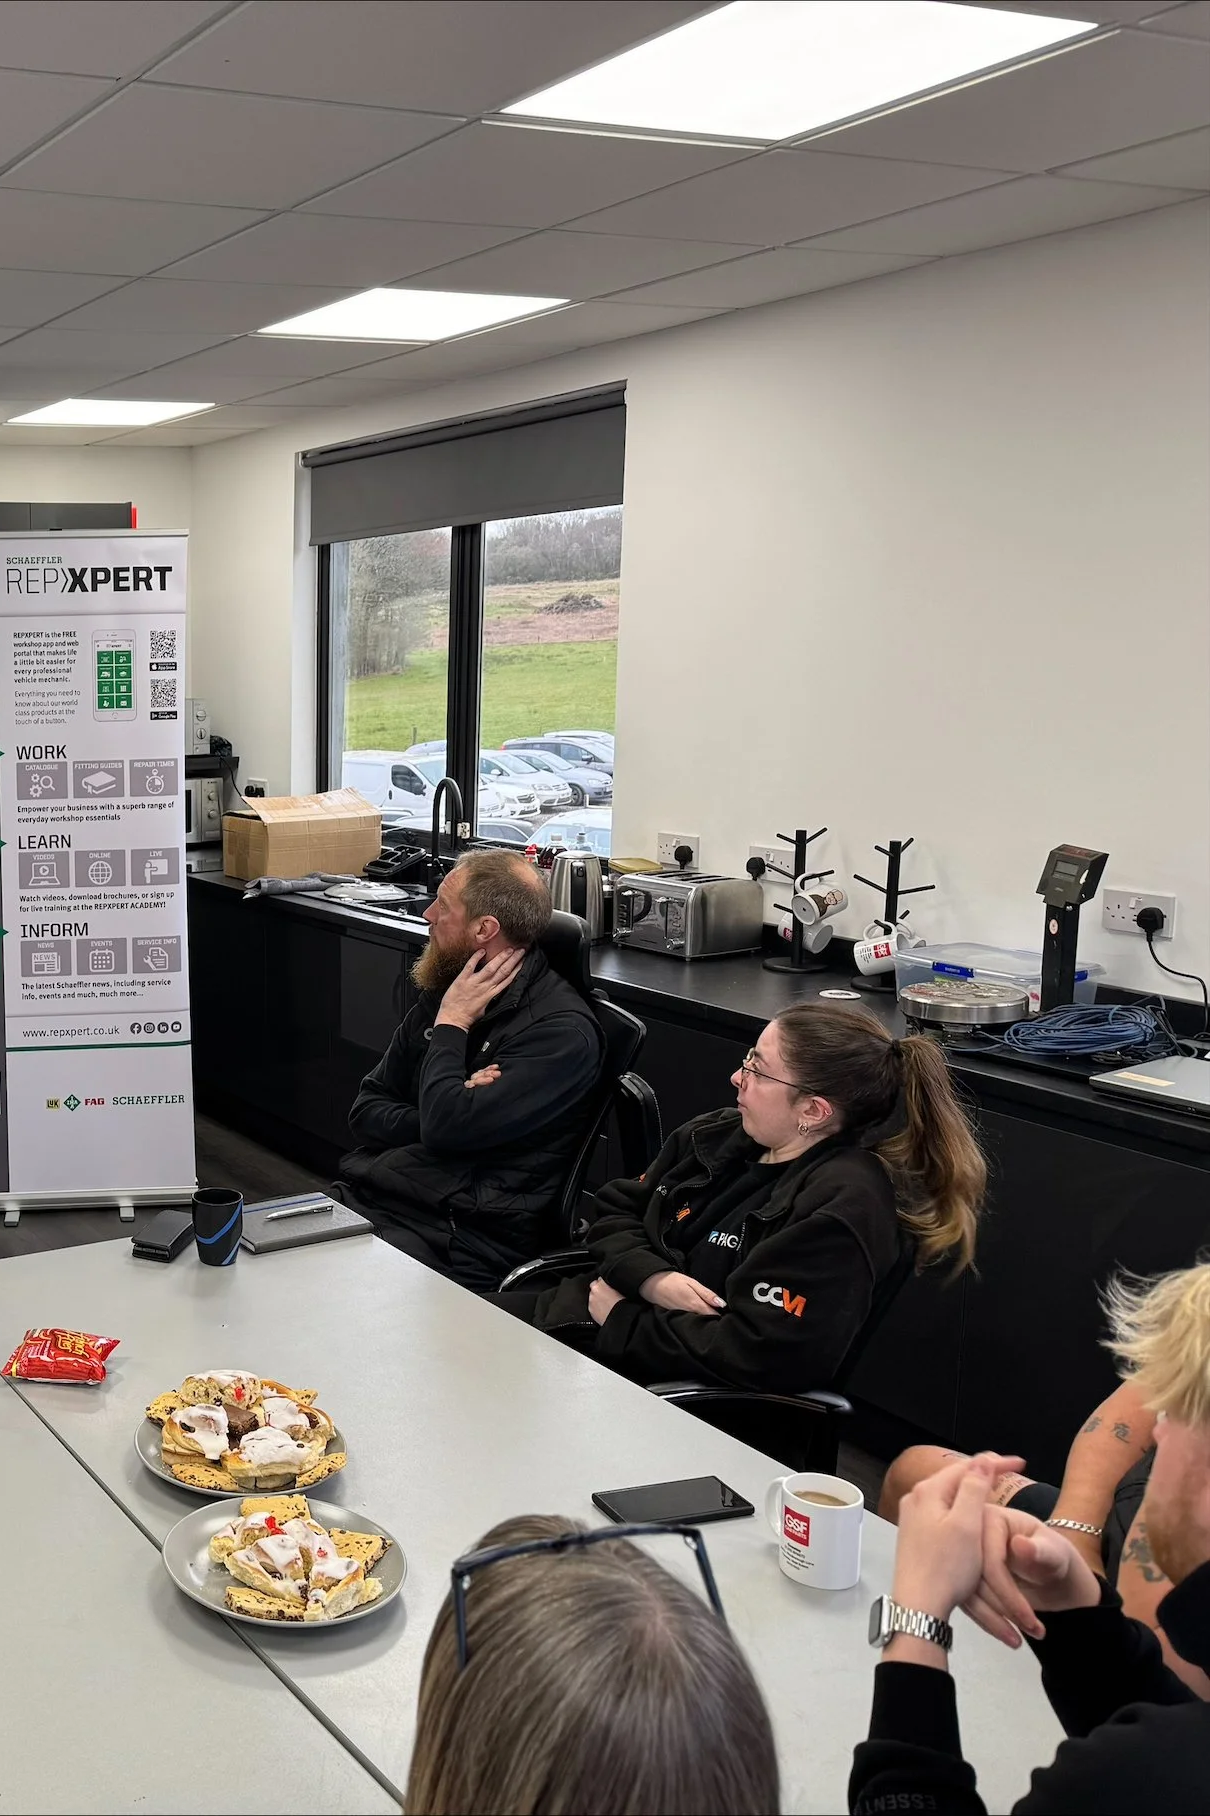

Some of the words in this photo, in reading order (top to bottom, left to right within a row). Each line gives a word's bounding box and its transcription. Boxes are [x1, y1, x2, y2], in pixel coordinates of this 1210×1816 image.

[6, 556, 63, 565] SCHAEFFLER
[13, 631, 44, 639] REPXPERT
[13, 641, 42, 649] workshop
[13, 650, 32, 658] portal
[67, 648, 77, 656] life
[33, 667, 72, 675] professional
[14, 690, 46, 698] Everything
[46, 690, 57, 698] you
[31, 709, 57, 717] products
[16, 745, 67, 760] WORK
[17, 805, 49, 814] Empower
[50, 805, 66, 813] your
[122, 802, 146, 811] superb
[147, 802, 167, 810] range
[17, 816, 49, 824] everyday
[50, 815, 84, 823] workshop
[18, 834, 71, 850] LEARN
[42, 894, 67, 902] videos,
[68, 893, 102, 901] download
[103, 892, 140, 900] brochures,
[150, 891, 165, 899] sign
[44, 904, 72, 912] training
[81, 903, 93, 911] the
[94, 902, 129, 910] REPXPERT
[130, 901, 166, 909] ACADEMY!
[20, 922, 89, 938] INFORM
[137, 938, 162, 946] SERVICE
[35, 982, 55, 990] latest
[56, 981, 91, 989] Schaeffler
[92, 980, 113, 988] news,
[113, 979, 146, 987] including
[147, 978, 172, 986] service
[77, 991, 98, 999] much,
[99, 990, 118, 998] much
[22, 1025, 120, 1038] www.repxpert.co.uk
[84, 1098, 105, 1106] FAG
[112, 1095, 185, 1105] SCHAEFFLER
[752, 1282, 807, 1318] CCM
[786, 1514, 808, 1533] GSF
